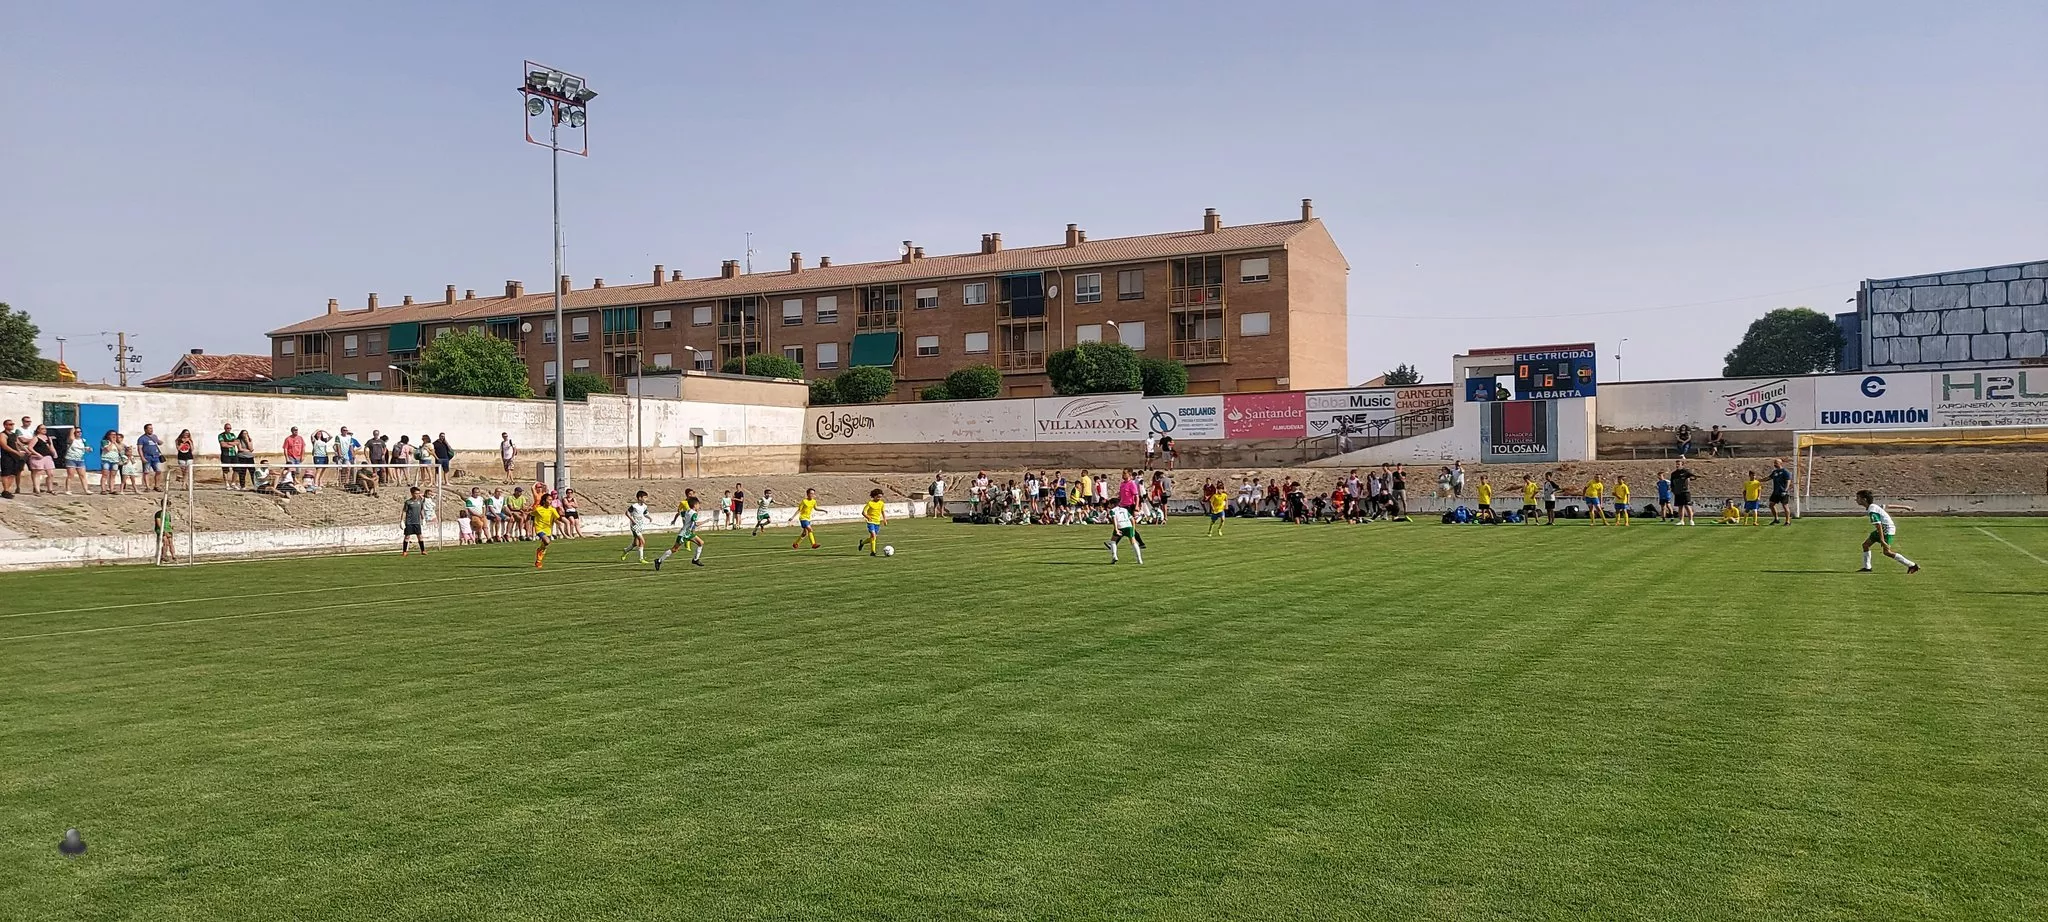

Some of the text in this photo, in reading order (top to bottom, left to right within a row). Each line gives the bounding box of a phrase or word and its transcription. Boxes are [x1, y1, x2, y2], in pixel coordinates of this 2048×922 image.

[1516, 350, 1594, 361] ELECTRICIDAD
[1519, 365, 1528, 378] 0
[1544, 375, 1553, 387] 6
[1529, 390, 1582, 399] LABARTA
[1179, 407, 1216, 416] ESCOLANOS
[1245, 406, 1304, 419] Santander
[1821, 406, 1928, 424] EUROCAMIÓN
[1038, 417, 1140, 431] VILLAMAYOR
[1492, 444, 1547, 453] TOLOSANA
